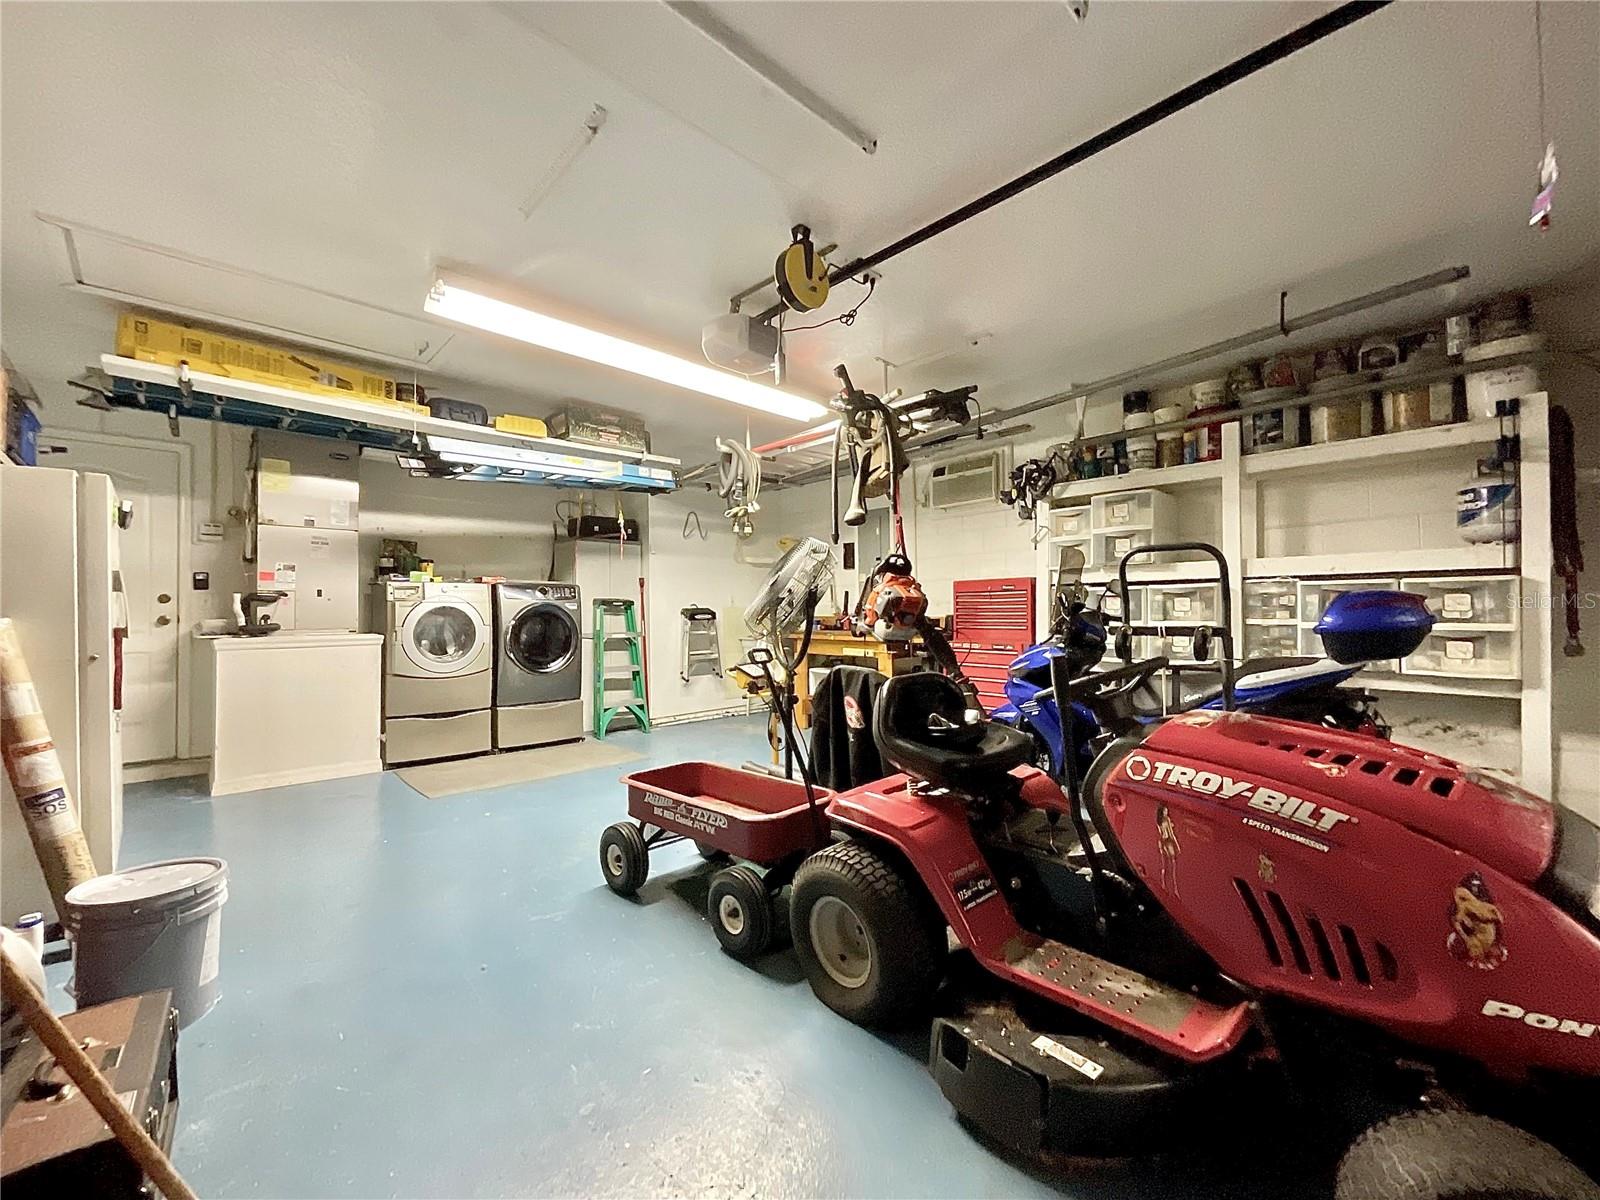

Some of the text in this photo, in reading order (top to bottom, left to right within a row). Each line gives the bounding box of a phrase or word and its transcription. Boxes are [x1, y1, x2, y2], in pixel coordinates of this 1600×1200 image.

[30, 800, 67, 818] SOS
[1154, 762, 1350, 832] TROY-BILT
[691, 806, 728, 829] FLYER
[1248, 819, 1271, 831] SPEED
[1271, 826, 1330, 853] TRANSMISSION
[1481, 1000, 1600, 1038] PON
